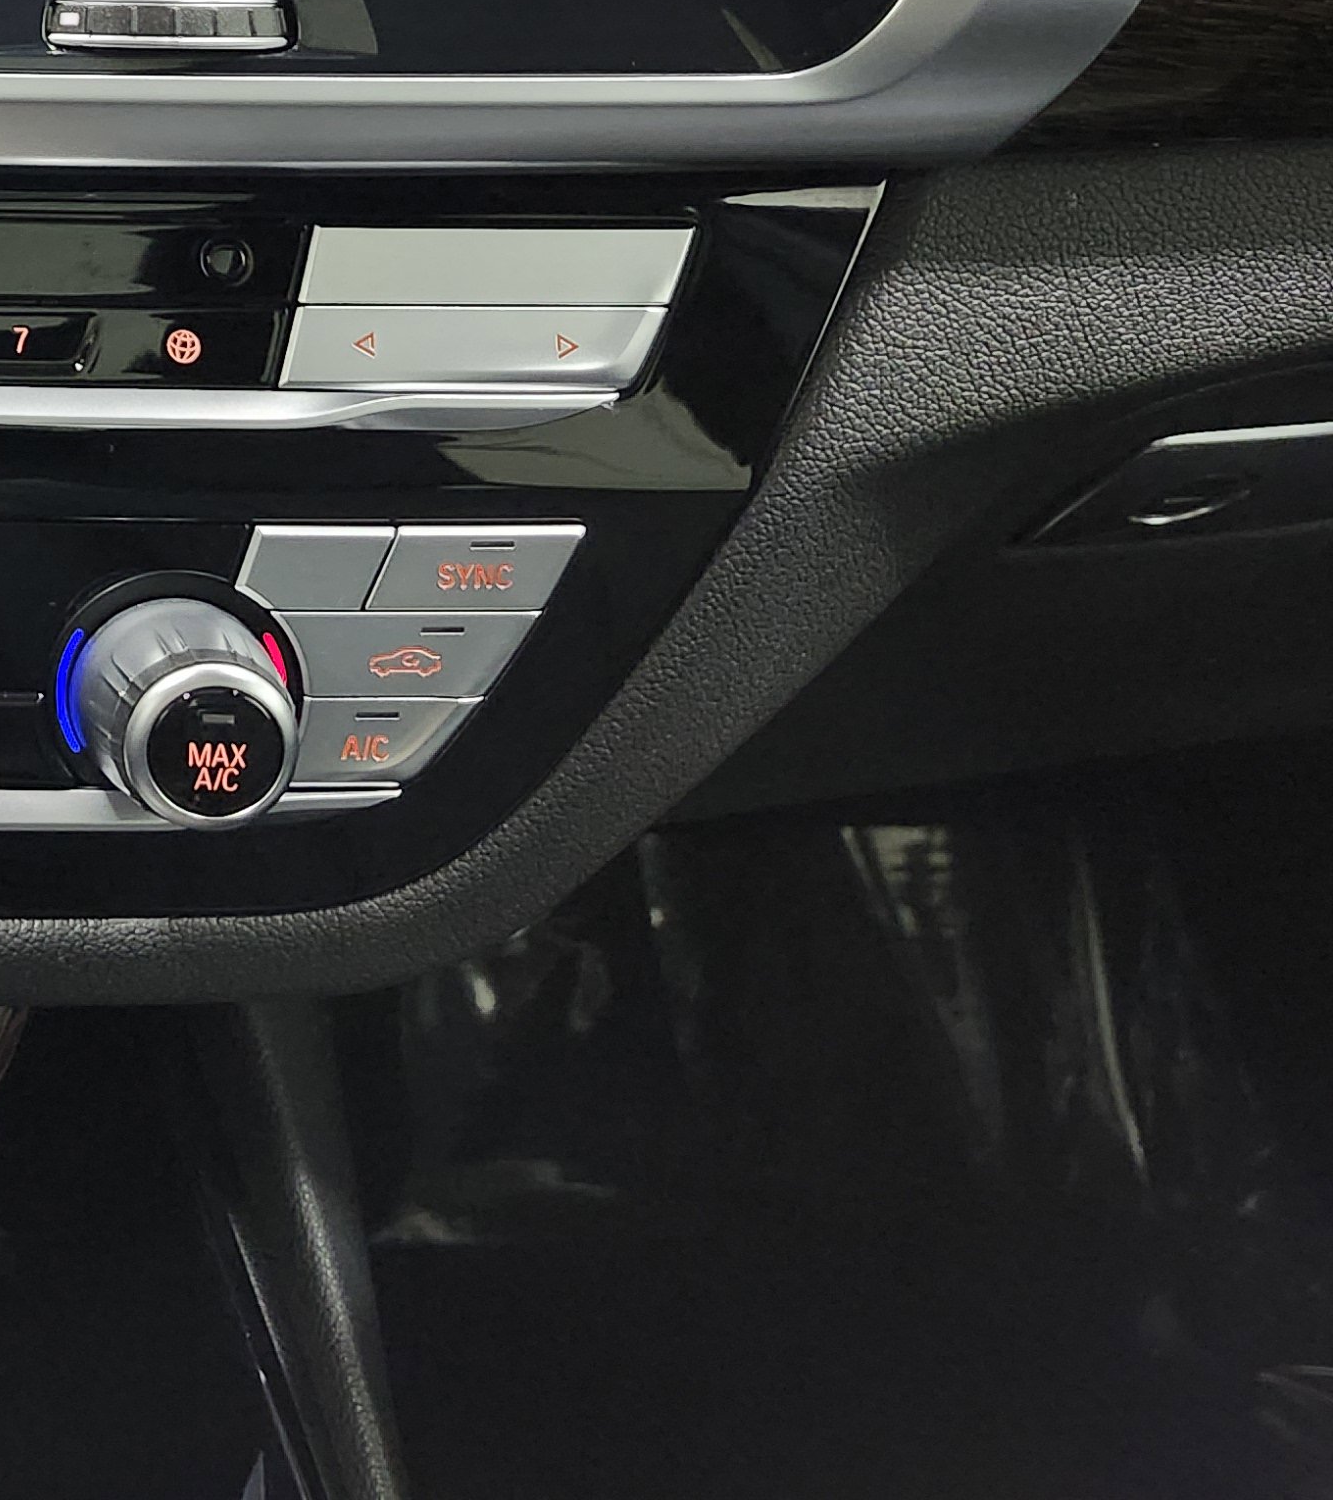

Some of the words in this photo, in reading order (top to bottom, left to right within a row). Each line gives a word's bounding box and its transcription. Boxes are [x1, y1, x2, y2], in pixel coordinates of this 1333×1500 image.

[13, 327, 30, 354] 7
[436, 562, 515, 590] SYNC
[188, 742, 247, 770] MAX
[340, 735, 390, 762] A/C
[193, 767, 240, 793] A/C
